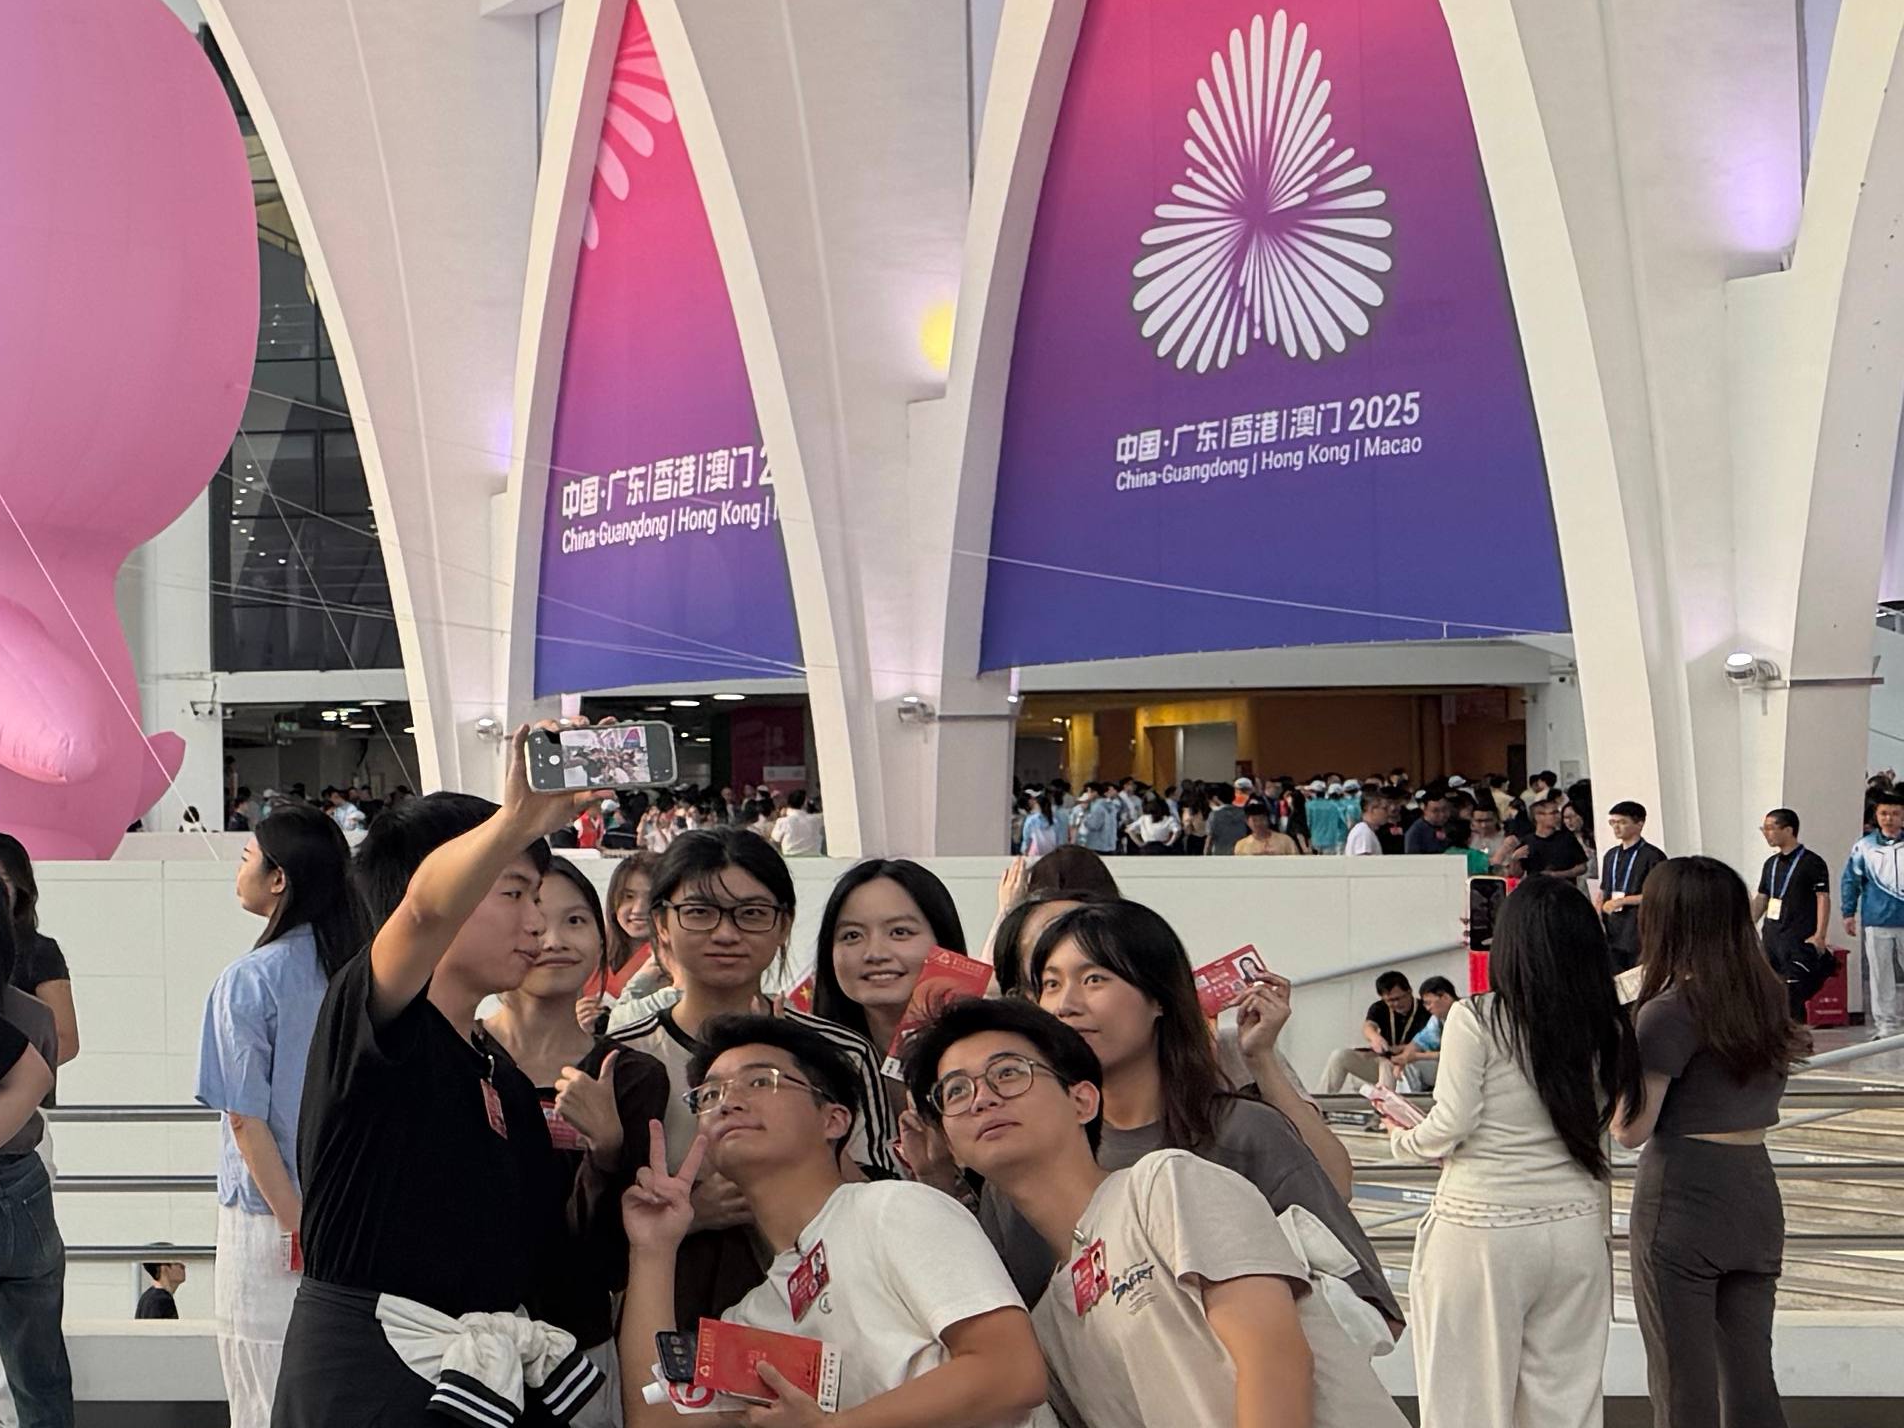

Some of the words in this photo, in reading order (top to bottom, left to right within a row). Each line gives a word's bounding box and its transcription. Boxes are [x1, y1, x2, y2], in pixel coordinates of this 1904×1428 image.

[1349, 391, 1422, 431] 2025
[1261, 449, 1304, 474] Hong
[1307, 441, 1351, 466] Kong
[1363, 434, 1423, 457] Macao
[677, 506, 717, 535] Hong
[720, 498, 761, 531] Kong
